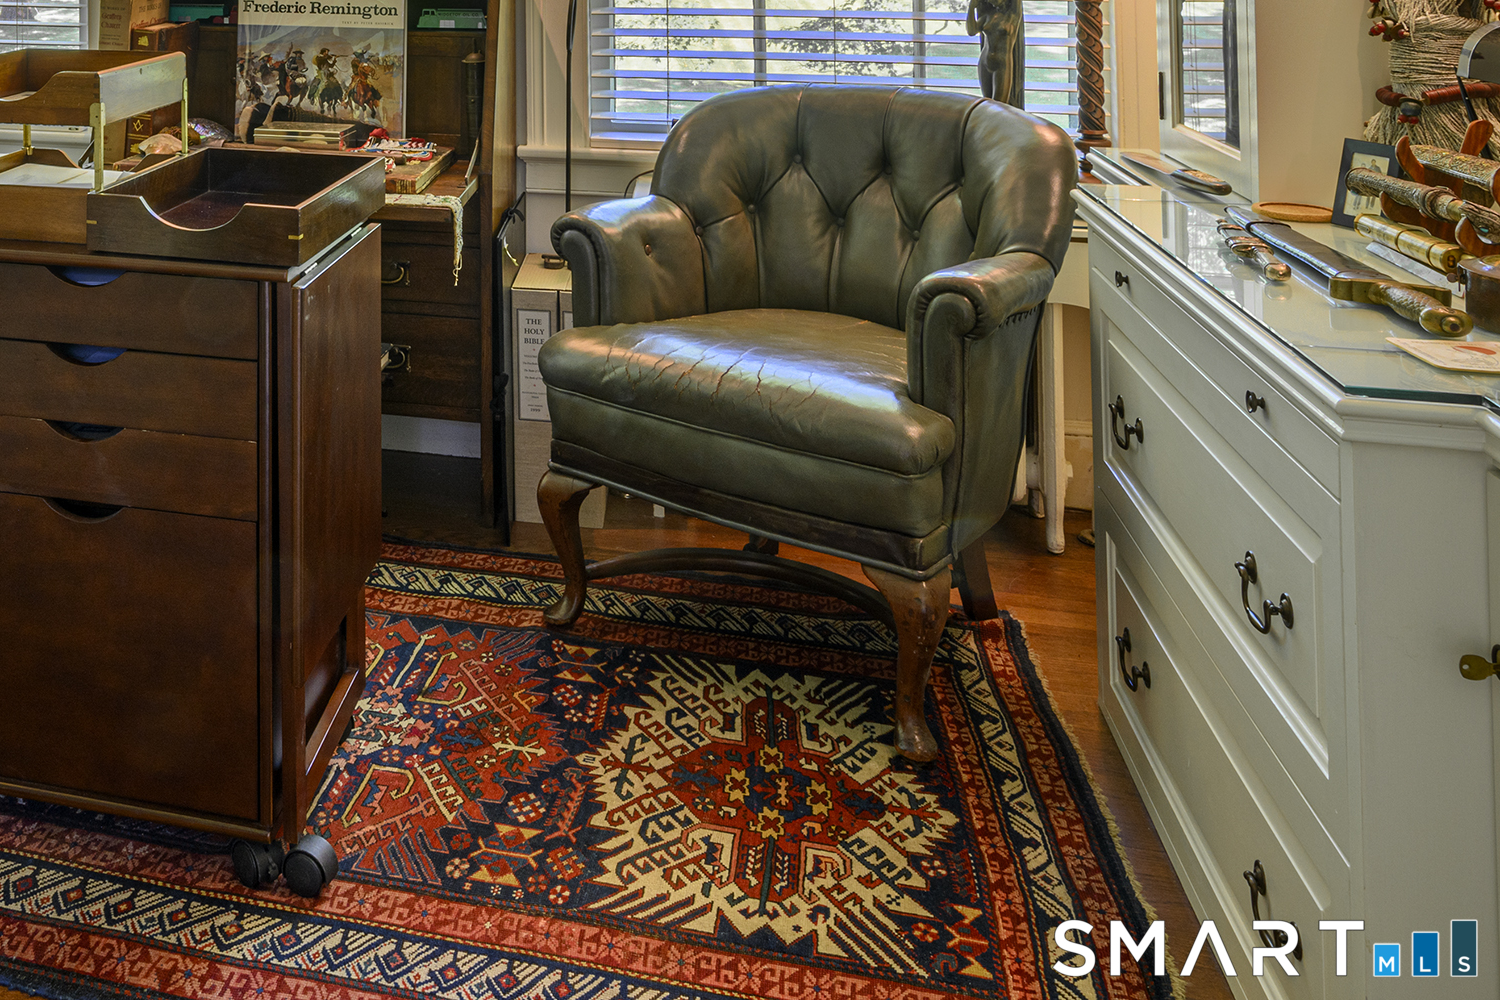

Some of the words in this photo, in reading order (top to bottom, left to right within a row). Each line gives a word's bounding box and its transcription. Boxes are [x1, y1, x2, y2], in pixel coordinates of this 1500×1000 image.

[242, 0, 306, 14] Frederic
[309, 2, 398, 20] Remington
[526, 318, 542, 326] THE
[524, 328, 545, 336] HOLY
